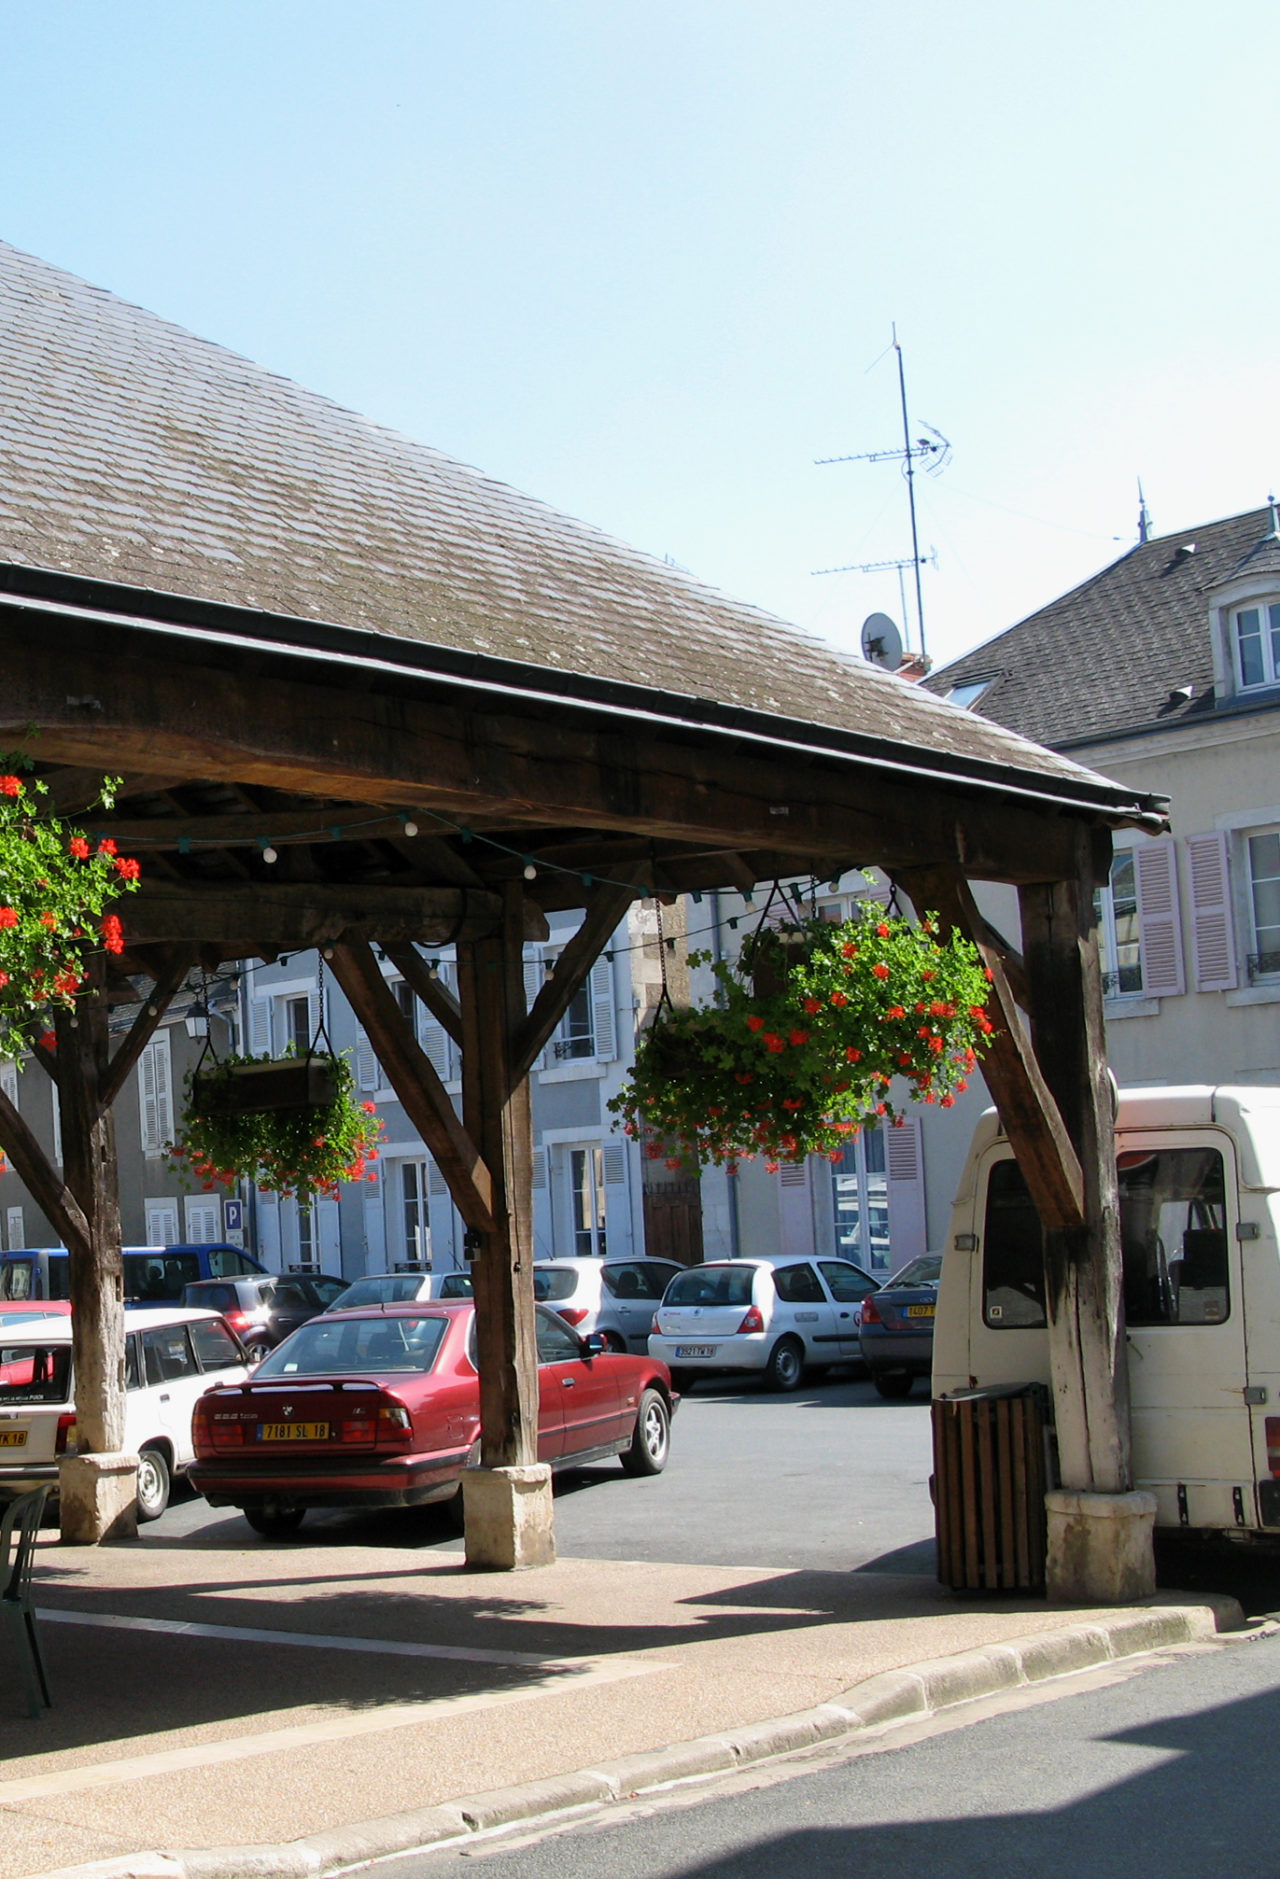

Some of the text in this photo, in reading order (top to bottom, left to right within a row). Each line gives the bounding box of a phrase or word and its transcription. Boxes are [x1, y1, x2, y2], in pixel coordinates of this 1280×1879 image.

[229, 1206, 237, 1225] P
[267, 1424, 325, 1438] 7181 SL 18
[13, 1433, 24, 1444] 18
